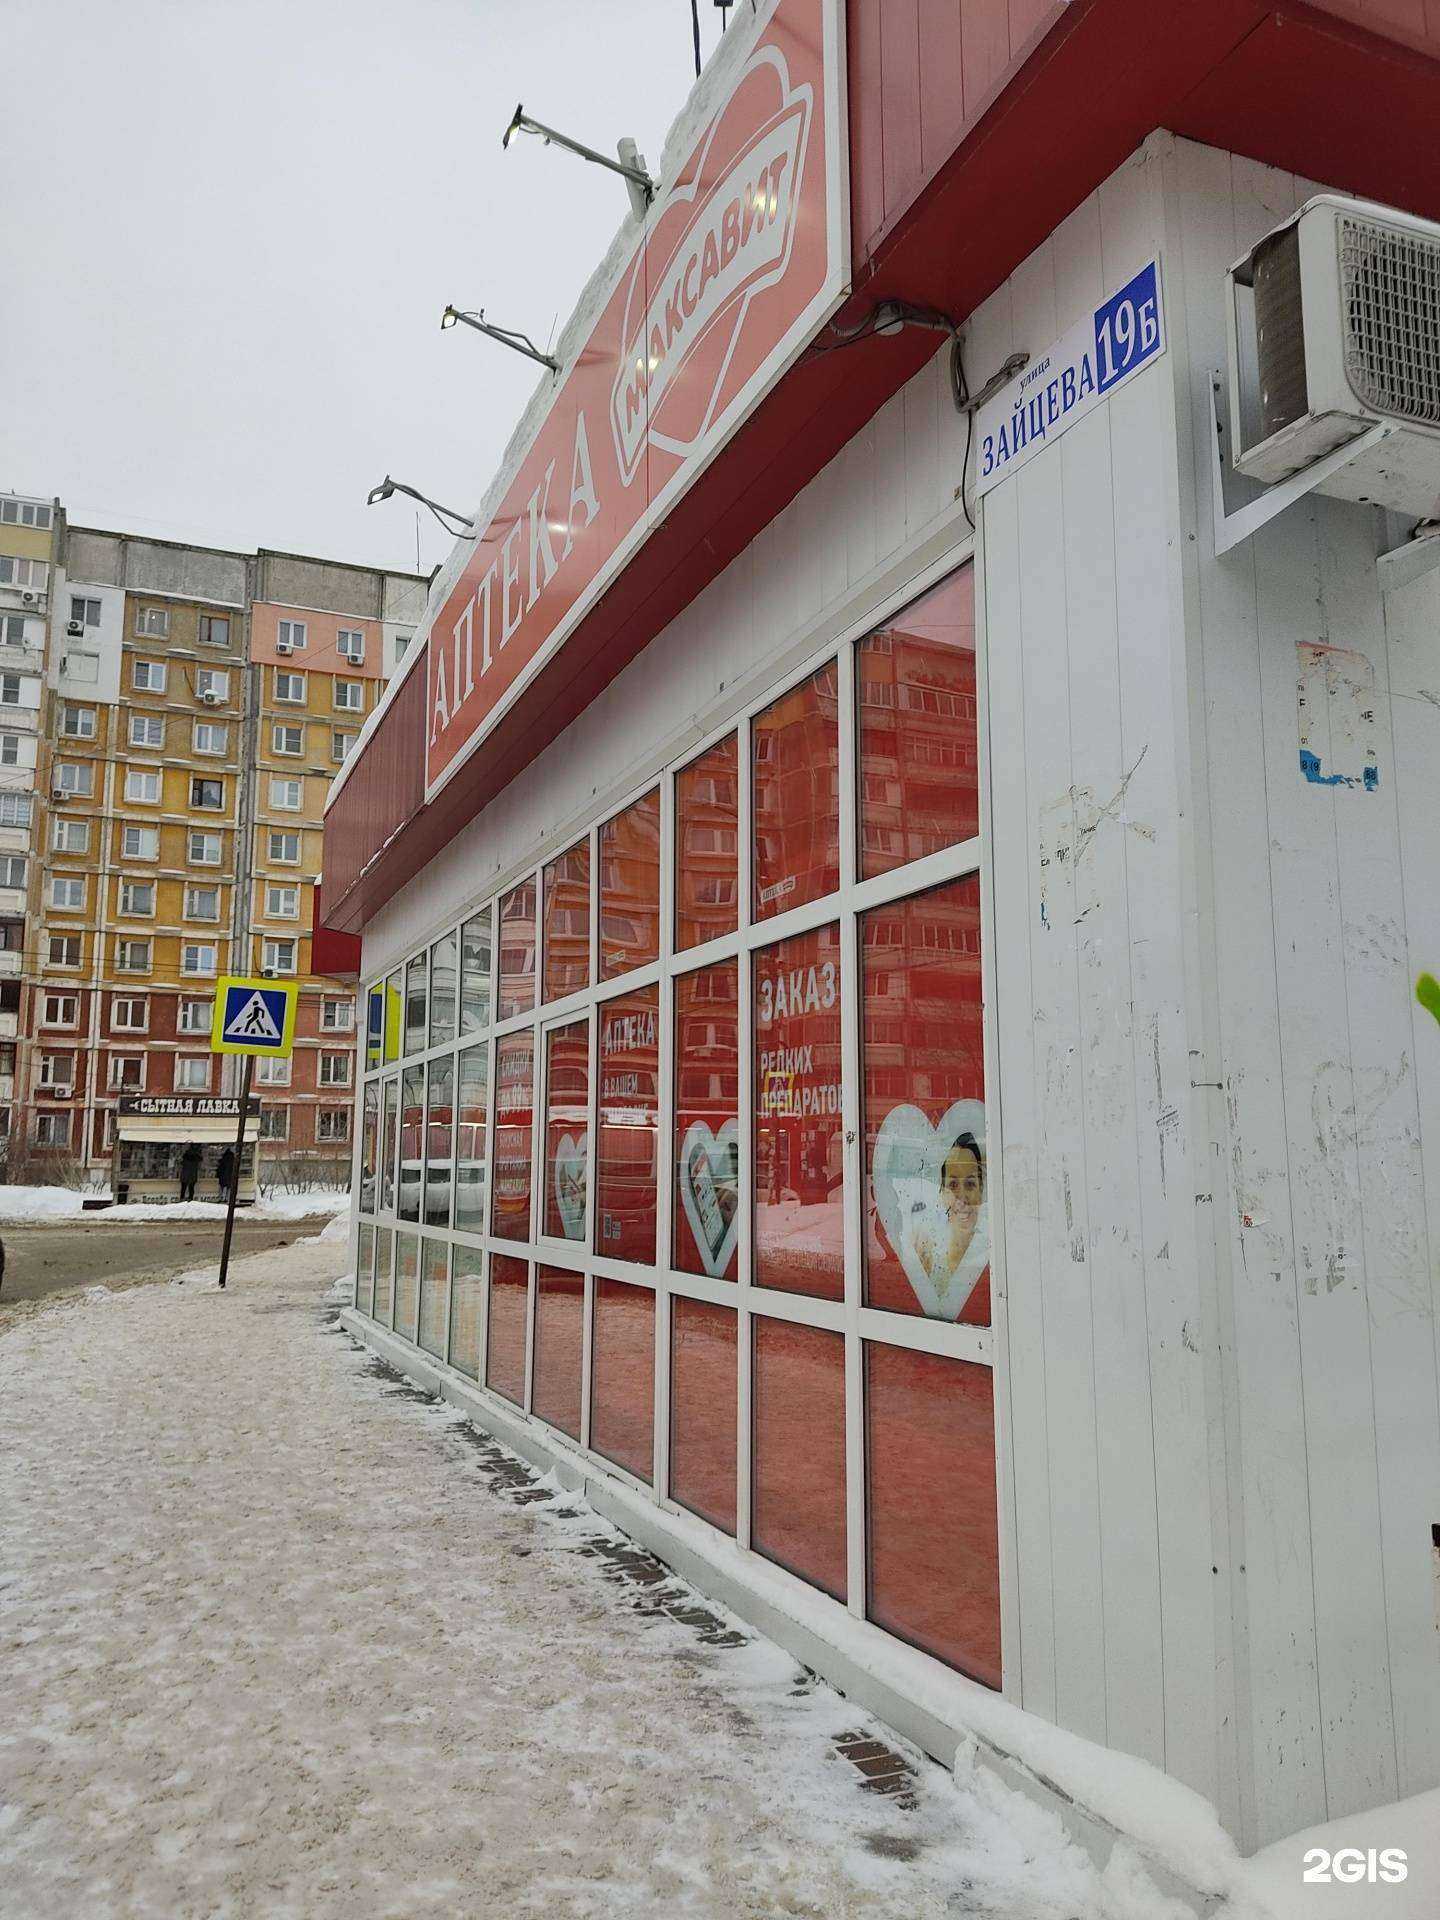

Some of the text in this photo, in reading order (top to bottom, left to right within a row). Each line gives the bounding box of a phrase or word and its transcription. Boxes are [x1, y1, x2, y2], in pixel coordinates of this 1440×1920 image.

[623, 149, 789, 434] МАКСАВИТ
[1099, 299, 1157, 386] 19Б
[1018, 357, 1050, 394] улица
[983, 354, 1095, 476] ЗАЙЦЕВА
[430, 410, 600, 748] АПТЕКА
[761, 962, 836, 1022] ЗАКАЗ
[604, 1010, 654, 1055] АПТЕКА
[761, 1045, 813, 1079] РЕДКИХ
[140, 1099, 240, 1113] СЫТНАЯ ЛАВКА
